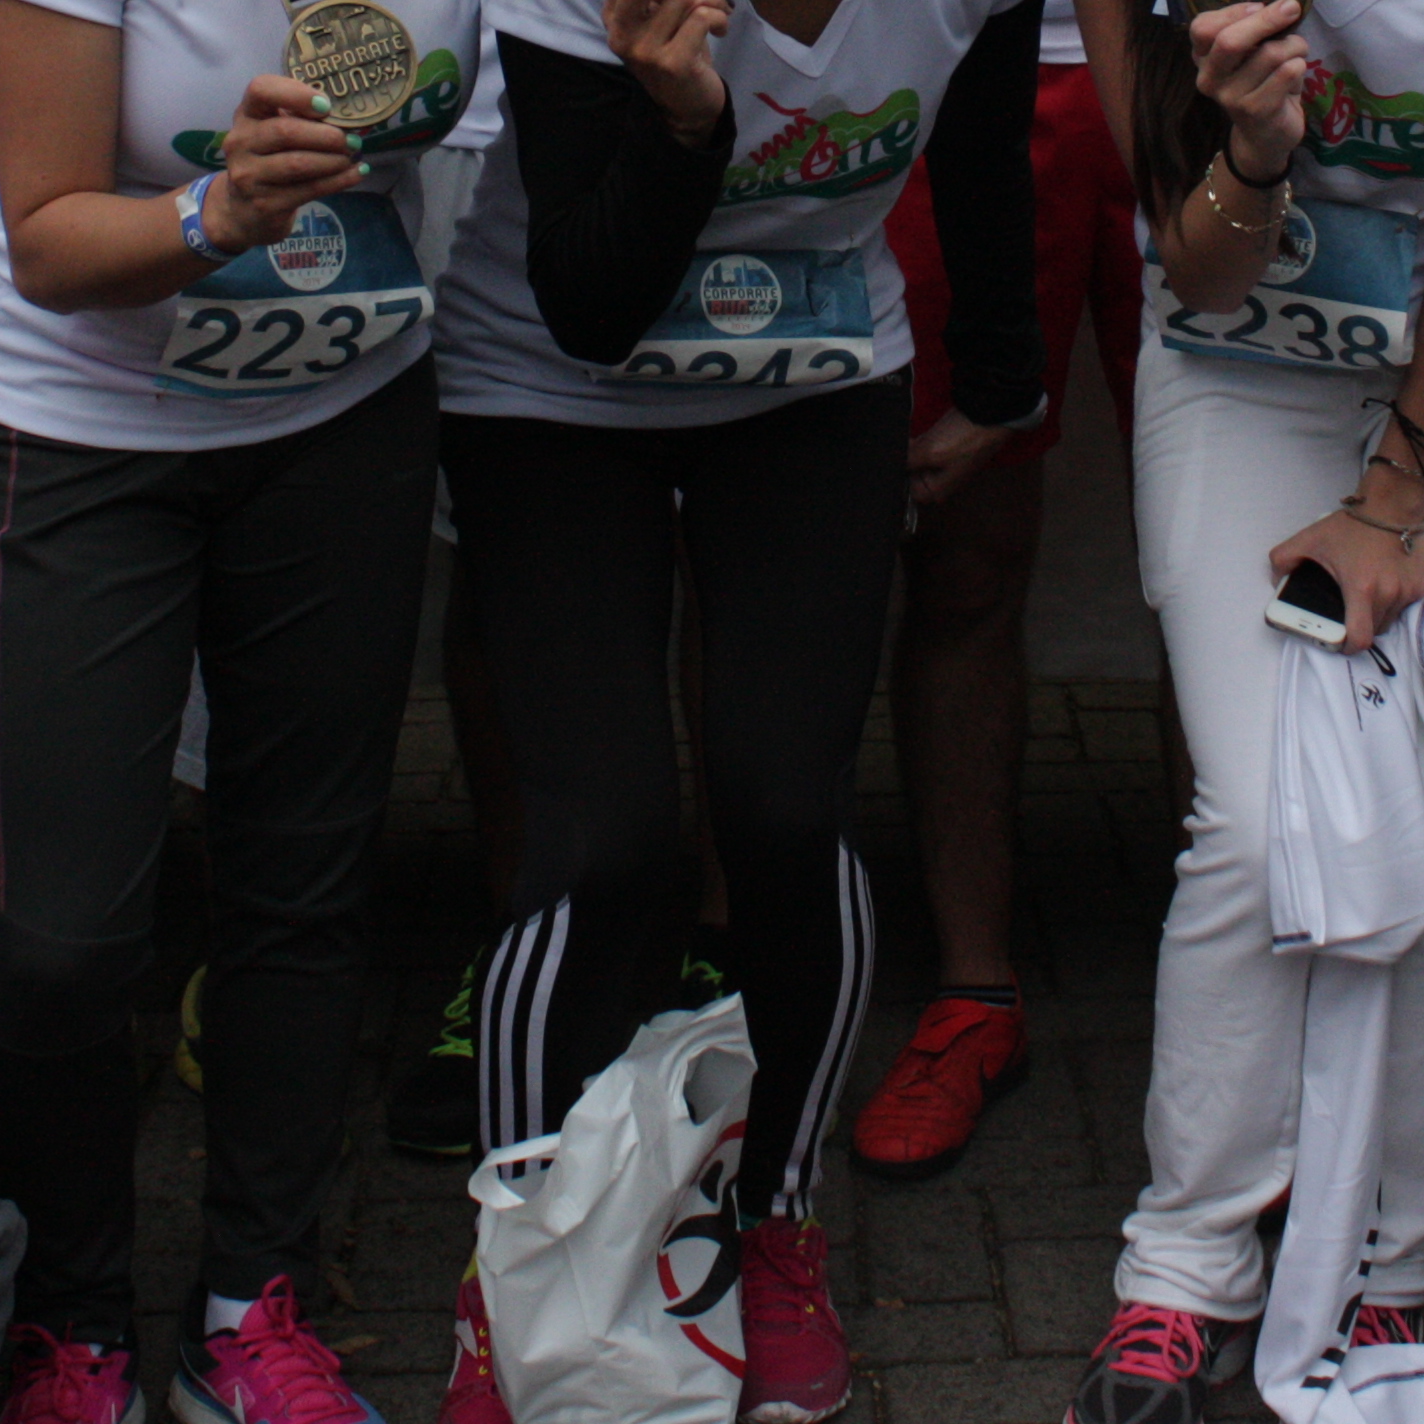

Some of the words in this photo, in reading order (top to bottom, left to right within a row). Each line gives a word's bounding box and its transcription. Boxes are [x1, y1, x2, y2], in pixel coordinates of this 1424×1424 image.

[292, 33, 406, 82] CORPORATE
[272, 236, 344, 253] CORPORATE
[703, 287, 778, 299] CORPORATE
[711, 300, 750, 316] RUN
[172, 296, 423, 379] 2237
